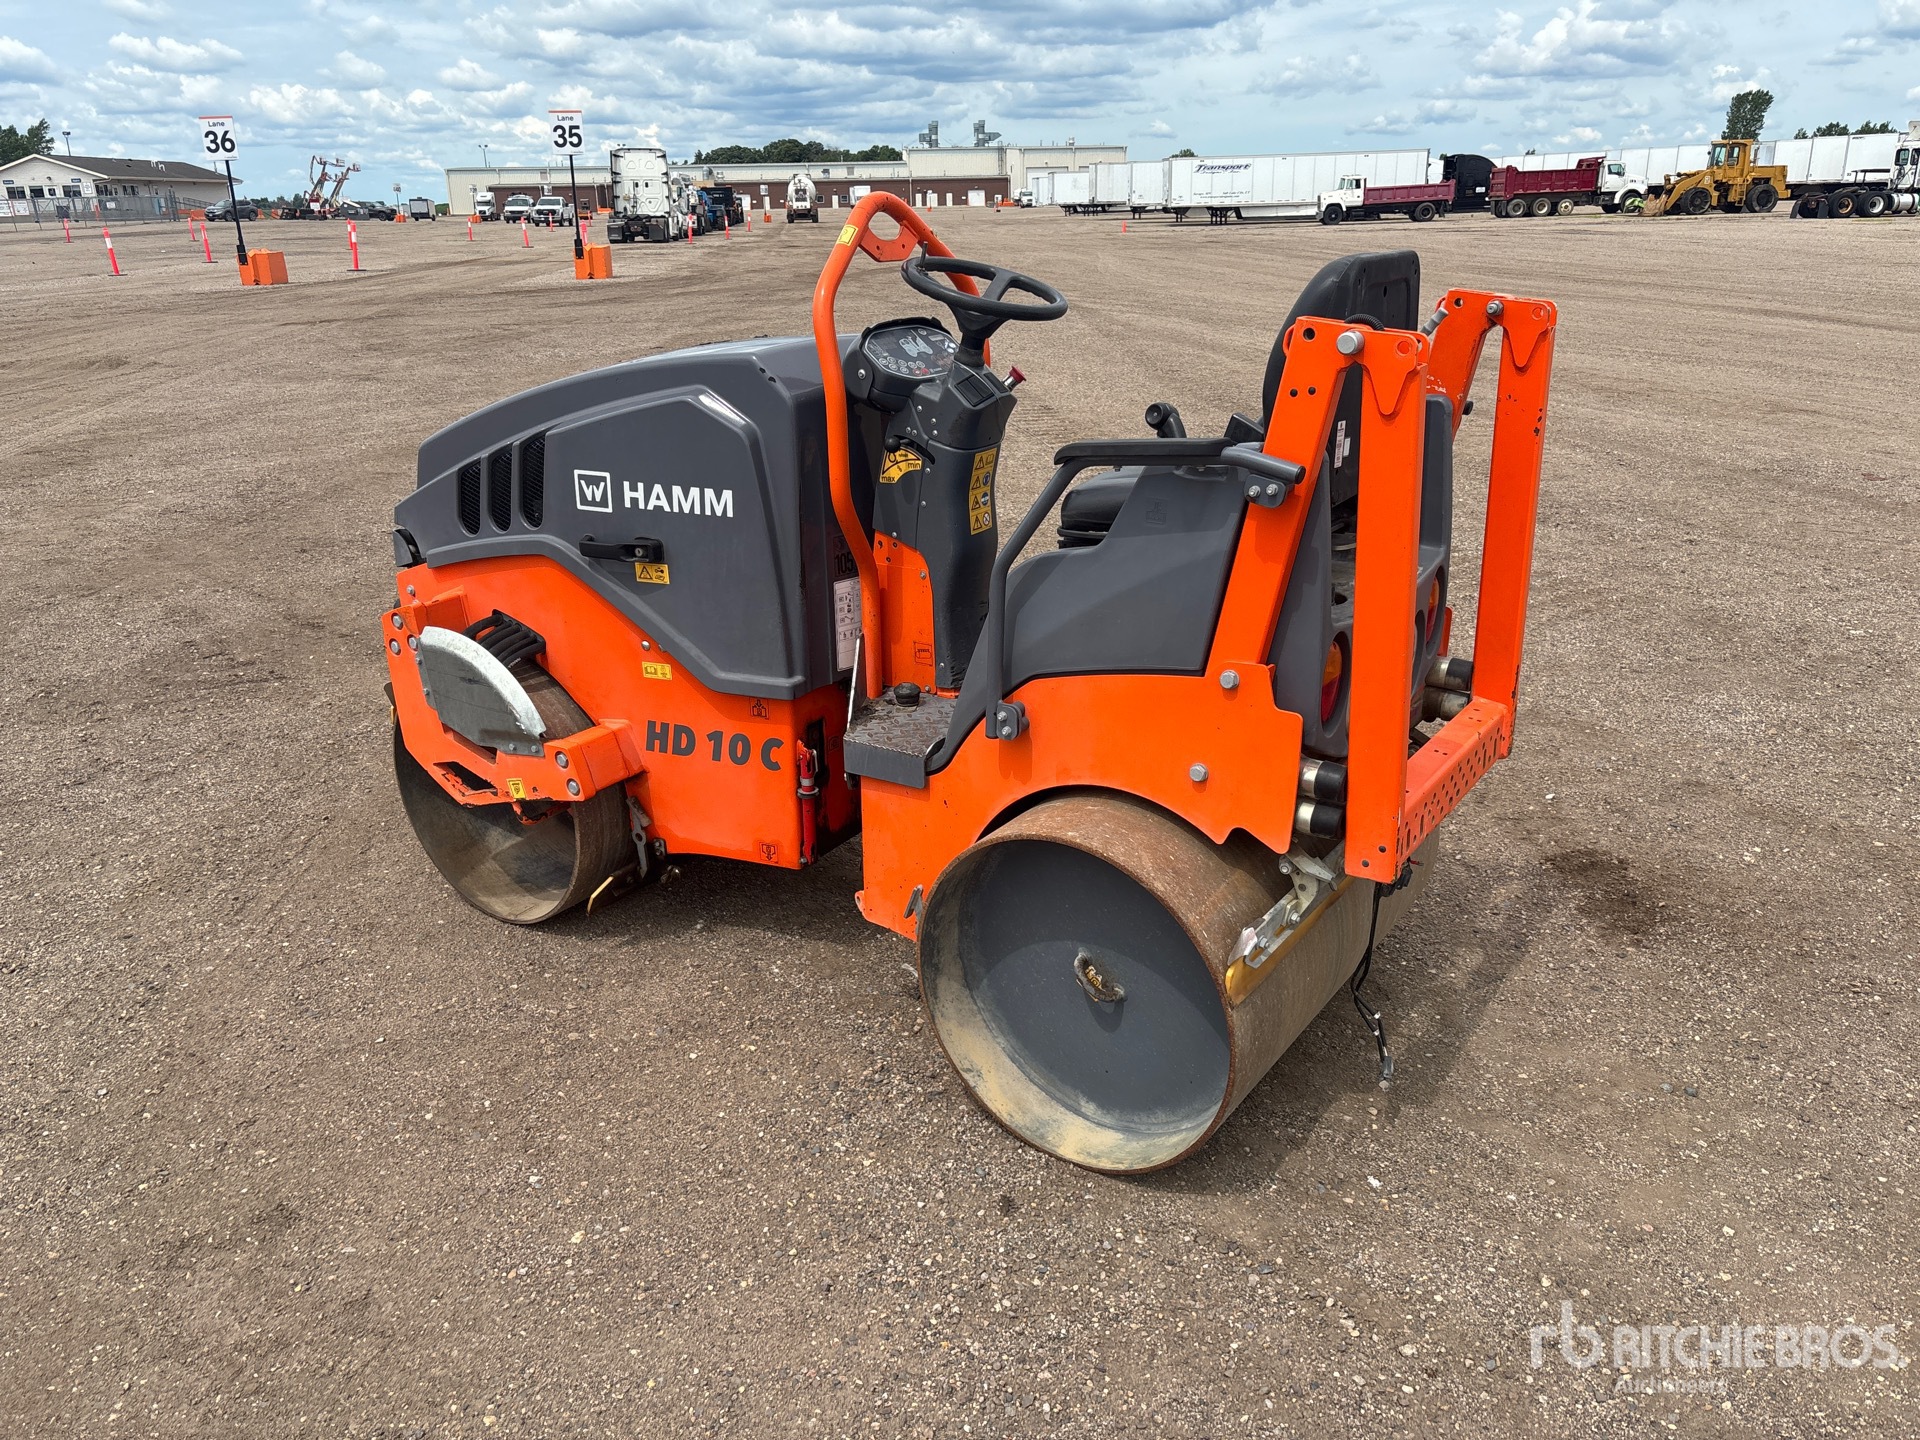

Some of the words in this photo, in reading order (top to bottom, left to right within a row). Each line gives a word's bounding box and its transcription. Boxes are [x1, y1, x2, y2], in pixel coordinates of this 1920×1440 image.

[204, 130, 236, 154] 36
[553, 125, 582, 148] 35
[1194, 163, 1252, 173] Transport
[908, 461, 920, 469] min
[623, 480, 734, 518] HAMM
[645, 720, 696, 757] HD
[706, 731, 751, 766] 10
[761, 738, 784, 772] C
